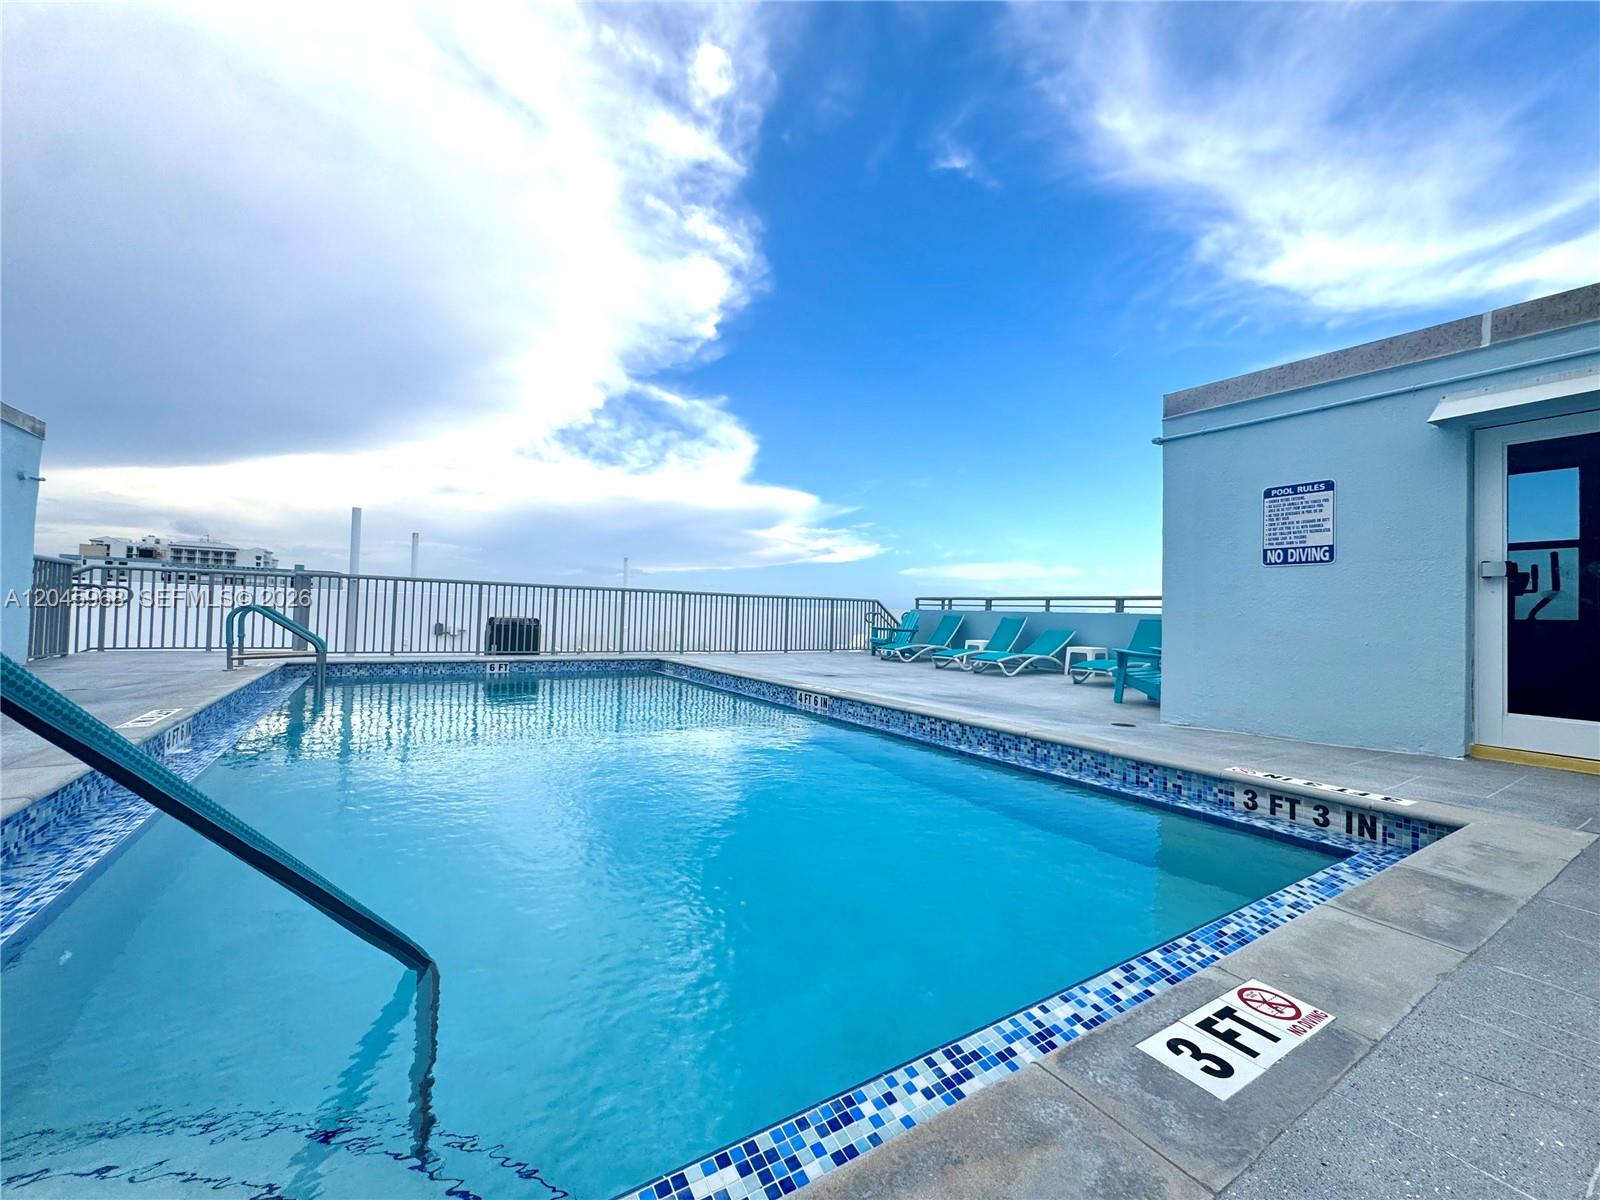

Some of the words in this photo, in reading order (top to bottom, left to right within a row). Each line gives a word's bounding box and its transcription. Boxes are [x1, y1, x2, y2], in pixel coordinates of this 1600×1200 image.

[1271, 487, 1294, 496] POOL
[1297, 483, 1326, 493] RULES
[1266, 549, 1283, 563] NO
[1287, 546, 1330, 562] DIVING
[798, 692, 803, 703] 4
[804, 694, 812, 704] FT
[813, 695, 818, 706] 6
[820, 697, 828, 708] IN
[1243, 789, 1258, 811] 3
[1269, 794, 1300, 821] FT
[1312, 804, 1331, 828] 3
[1345, 810, 1377, 840] IN
[1195, 1005, 1282, 1059] FT
[1286, 1024, 1308, 1037] NO
[1297, 1009, 1329, 1029] DIVING
[1166, 1037, 1235, 1079] 3
